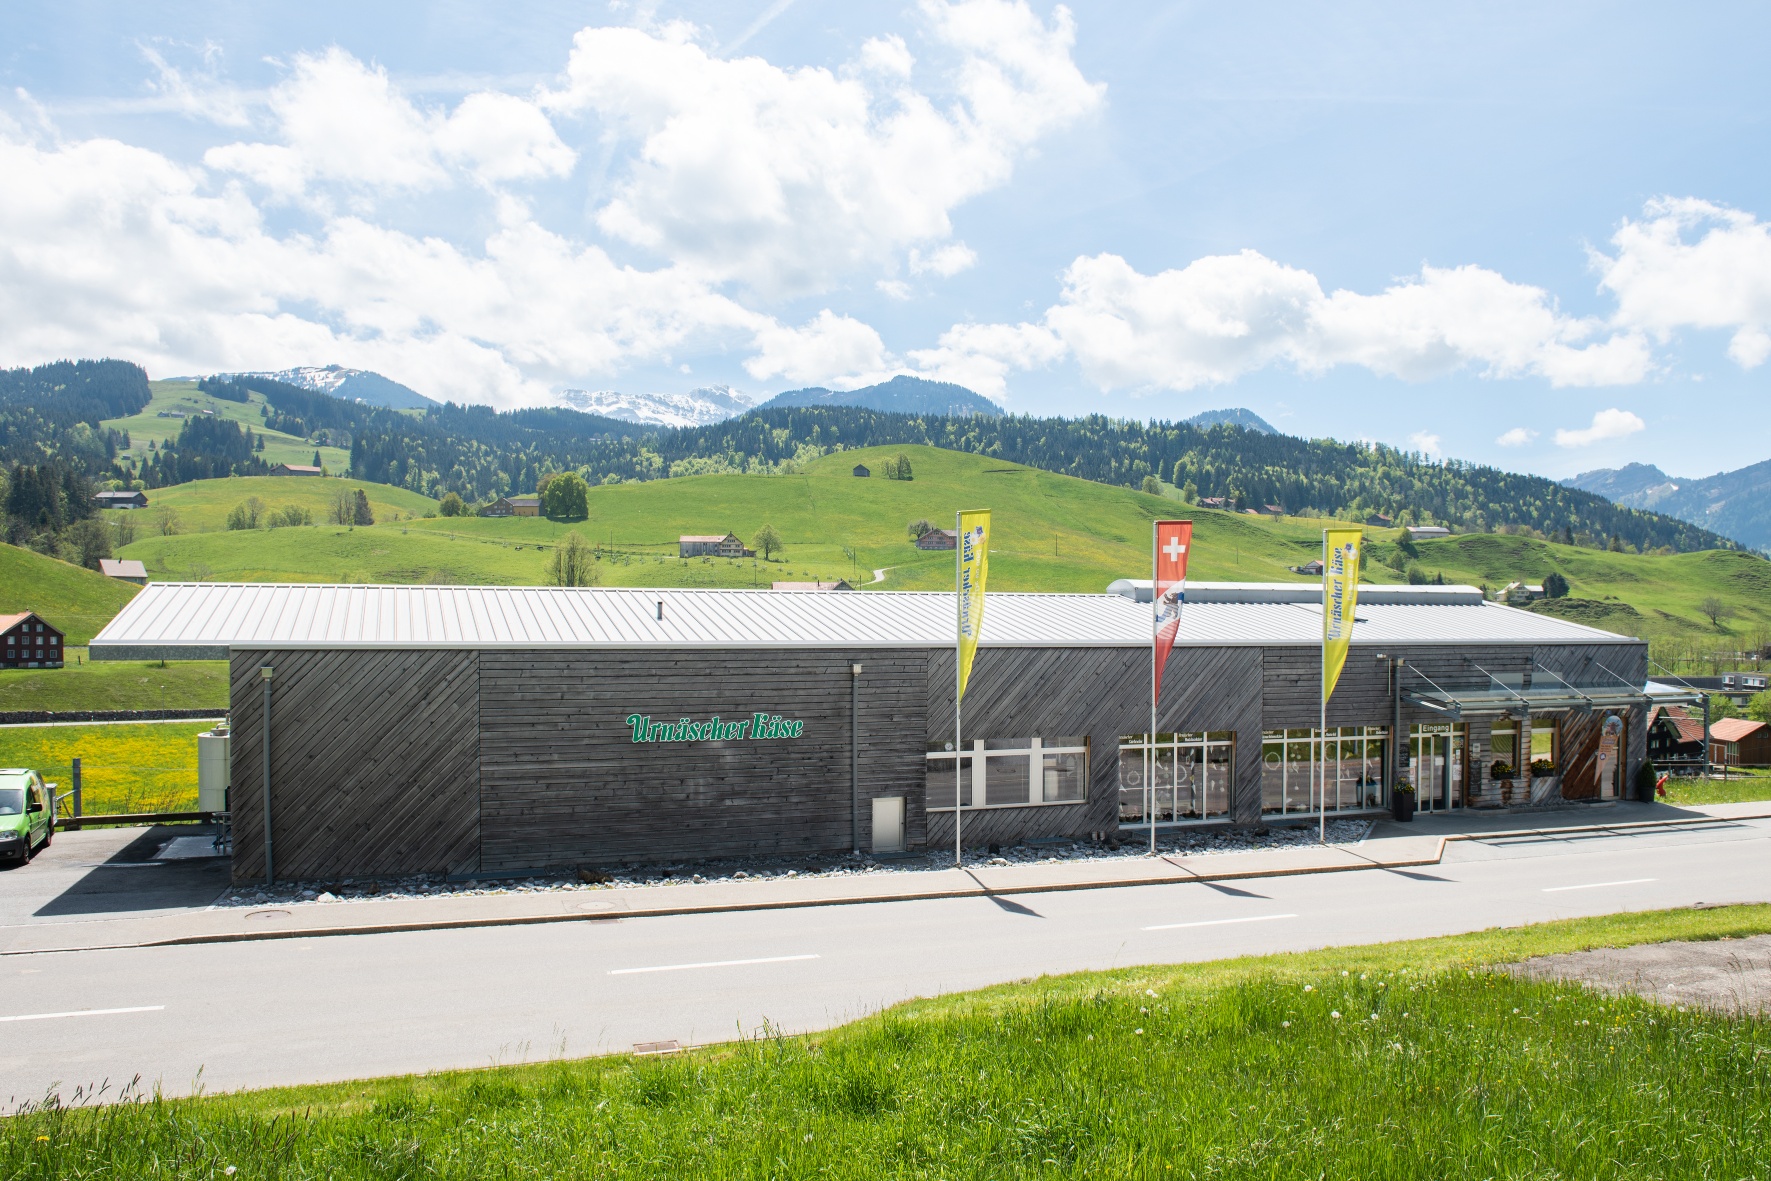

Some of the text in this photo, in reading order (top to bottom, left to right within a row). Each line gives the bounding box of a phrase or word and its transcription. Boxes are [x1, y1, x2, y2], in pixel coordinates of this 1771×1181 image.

[1327, 547, 1343, 641] Urnäscher Käse
[626, 712, 804, 743] Urnäscher Käse
[1422, 724, 1450, 733] Eingang
